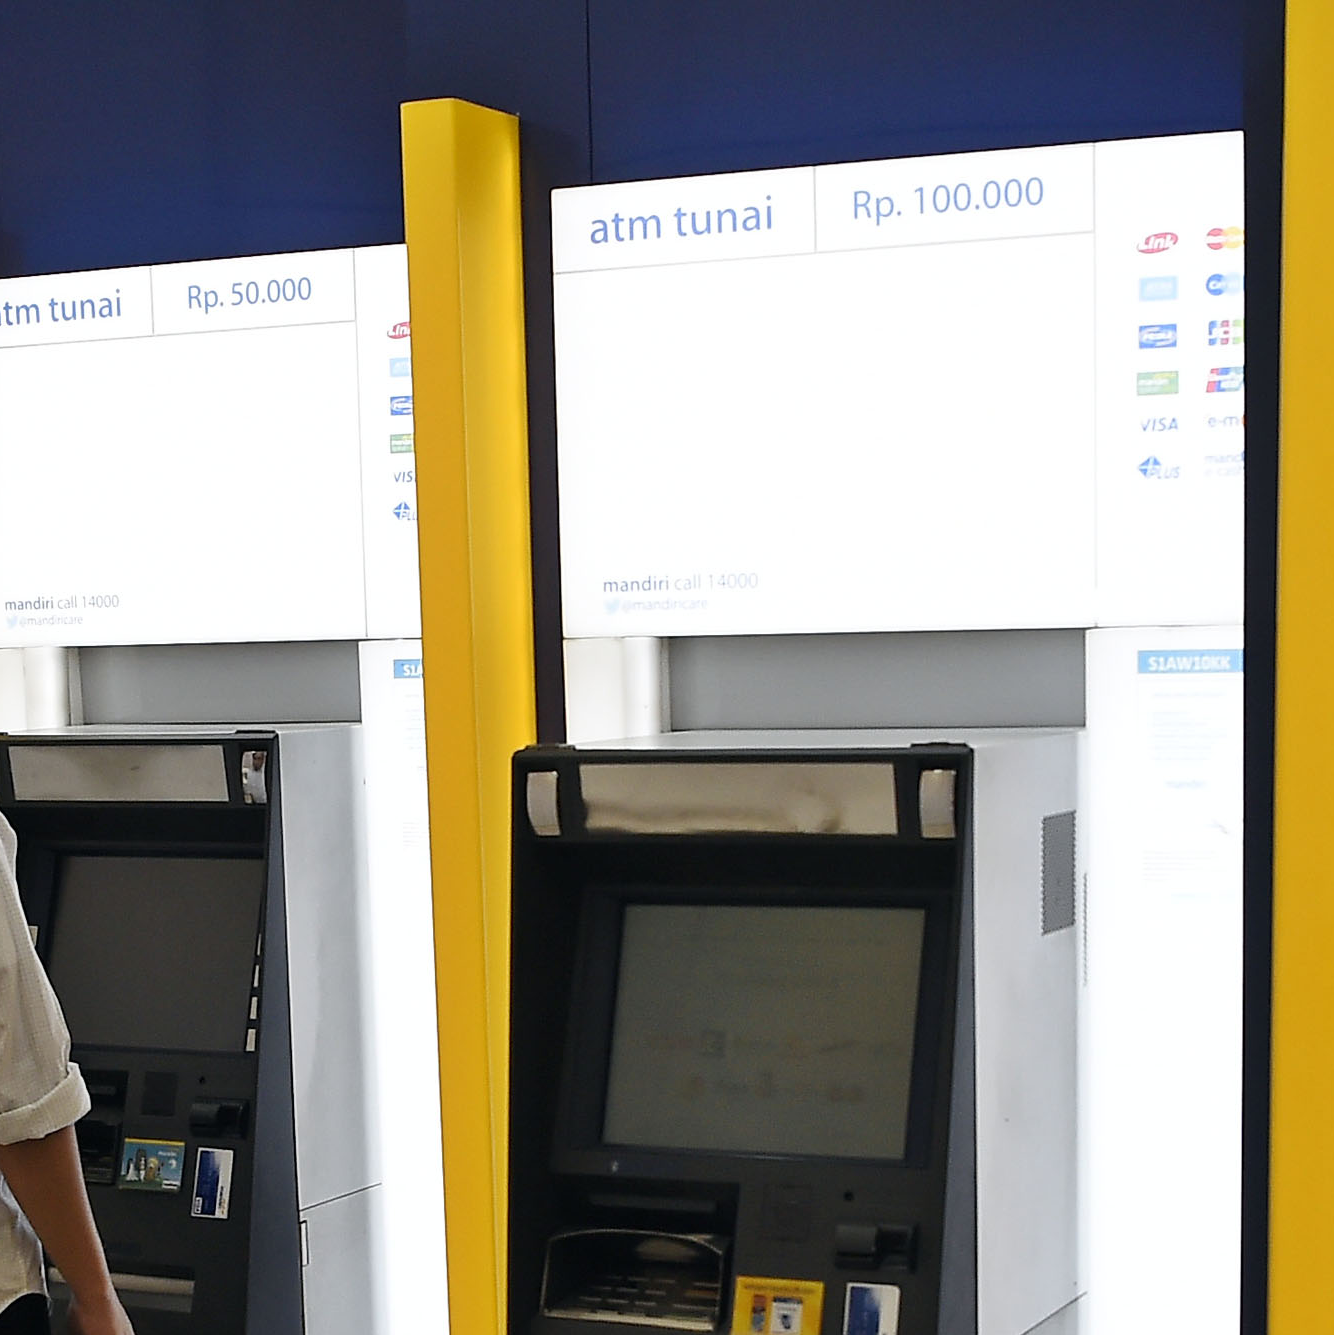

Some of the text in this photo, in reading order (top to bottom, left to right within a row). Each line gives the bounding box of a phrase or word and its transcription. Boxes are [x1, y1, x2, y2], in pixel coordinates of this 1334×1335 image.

[852, 176, 1045, 228] Rp. 100.000
[588, 195, 773, 245] atm tunai
[49, 289, 123, 323] tunai
[186, 276, 312, 314] Rp. 50.000
[1140, 416, 1179, 432] VISA
[603, 572, 758, 593] mandiri call 14000
[5, 593, 120, 611] mandiri call 14000
